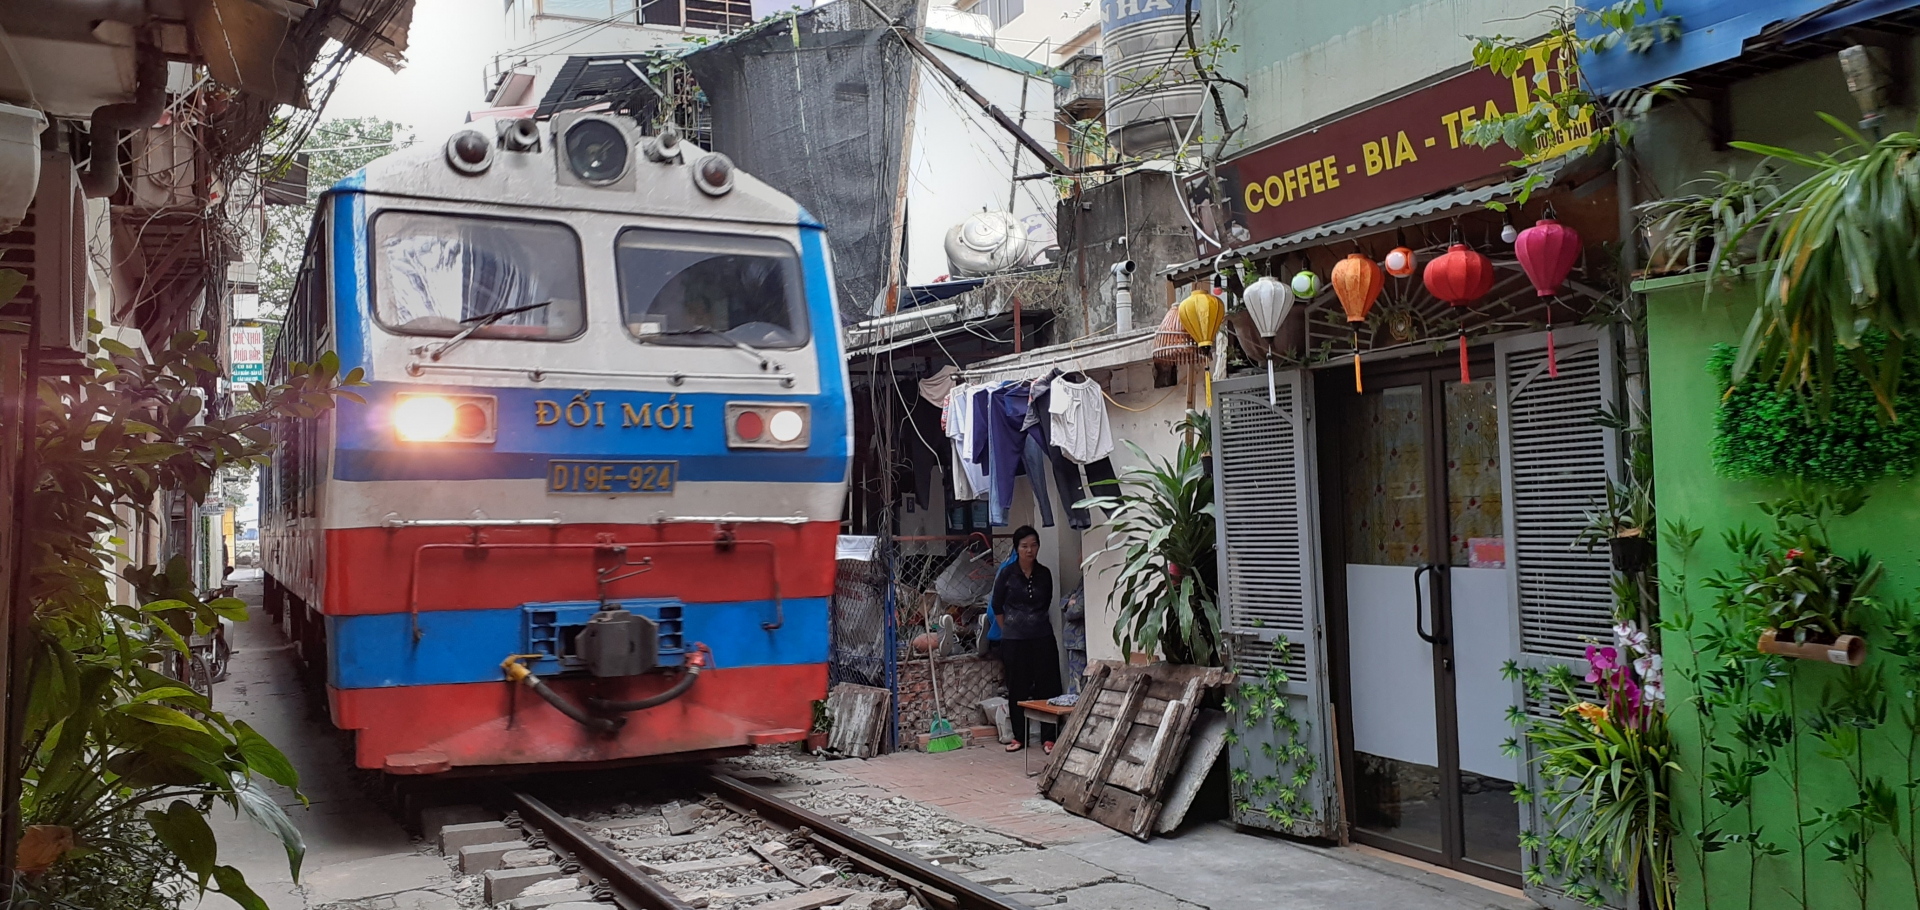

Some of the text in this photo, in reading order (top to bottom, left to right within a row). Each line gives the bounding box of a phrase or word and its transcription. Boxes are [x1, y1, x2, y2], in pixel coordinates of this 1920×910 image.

[1567, 121, 1588, 141] TÀU
[1244, 155, 1341, 213] COFFEE
[1362, 130, 1418, 177] BIA
[534, 389, 695, 430] ĐỔI MỚI
[552, 464, 672, 491] D19E-924
